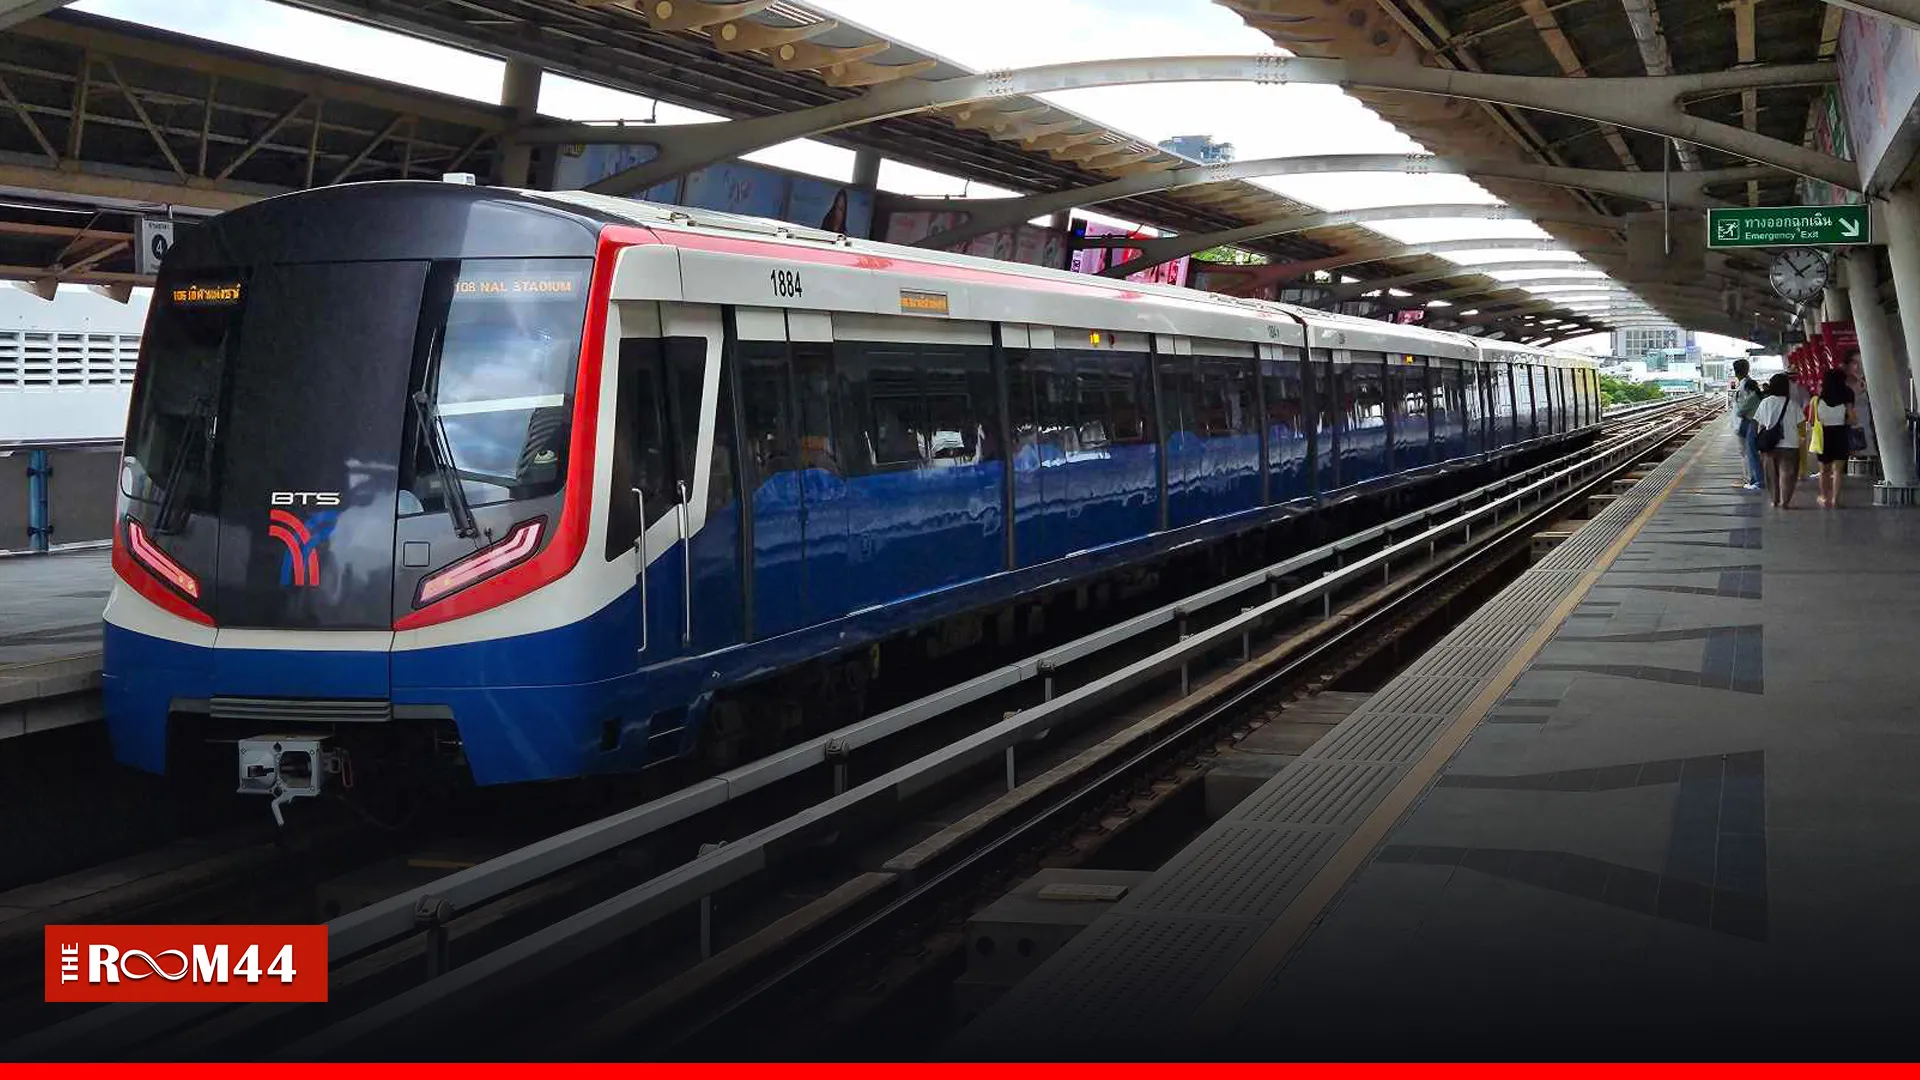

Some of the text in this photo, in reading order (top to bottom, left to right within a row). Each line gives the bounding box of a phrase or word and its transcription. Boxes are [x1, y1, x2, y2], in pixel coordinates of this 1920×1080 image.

[1745, 212, 1832, 232] ทางออกฉุกเฉิน
[1745, 230, 1819, 240] Emergency Exit
[156, 239, 163, 255] 4
[514, 280, 573, 292] STADIUM
[770, 269, 803, 298] 1884
[271, 492, 341, 505] BTS
